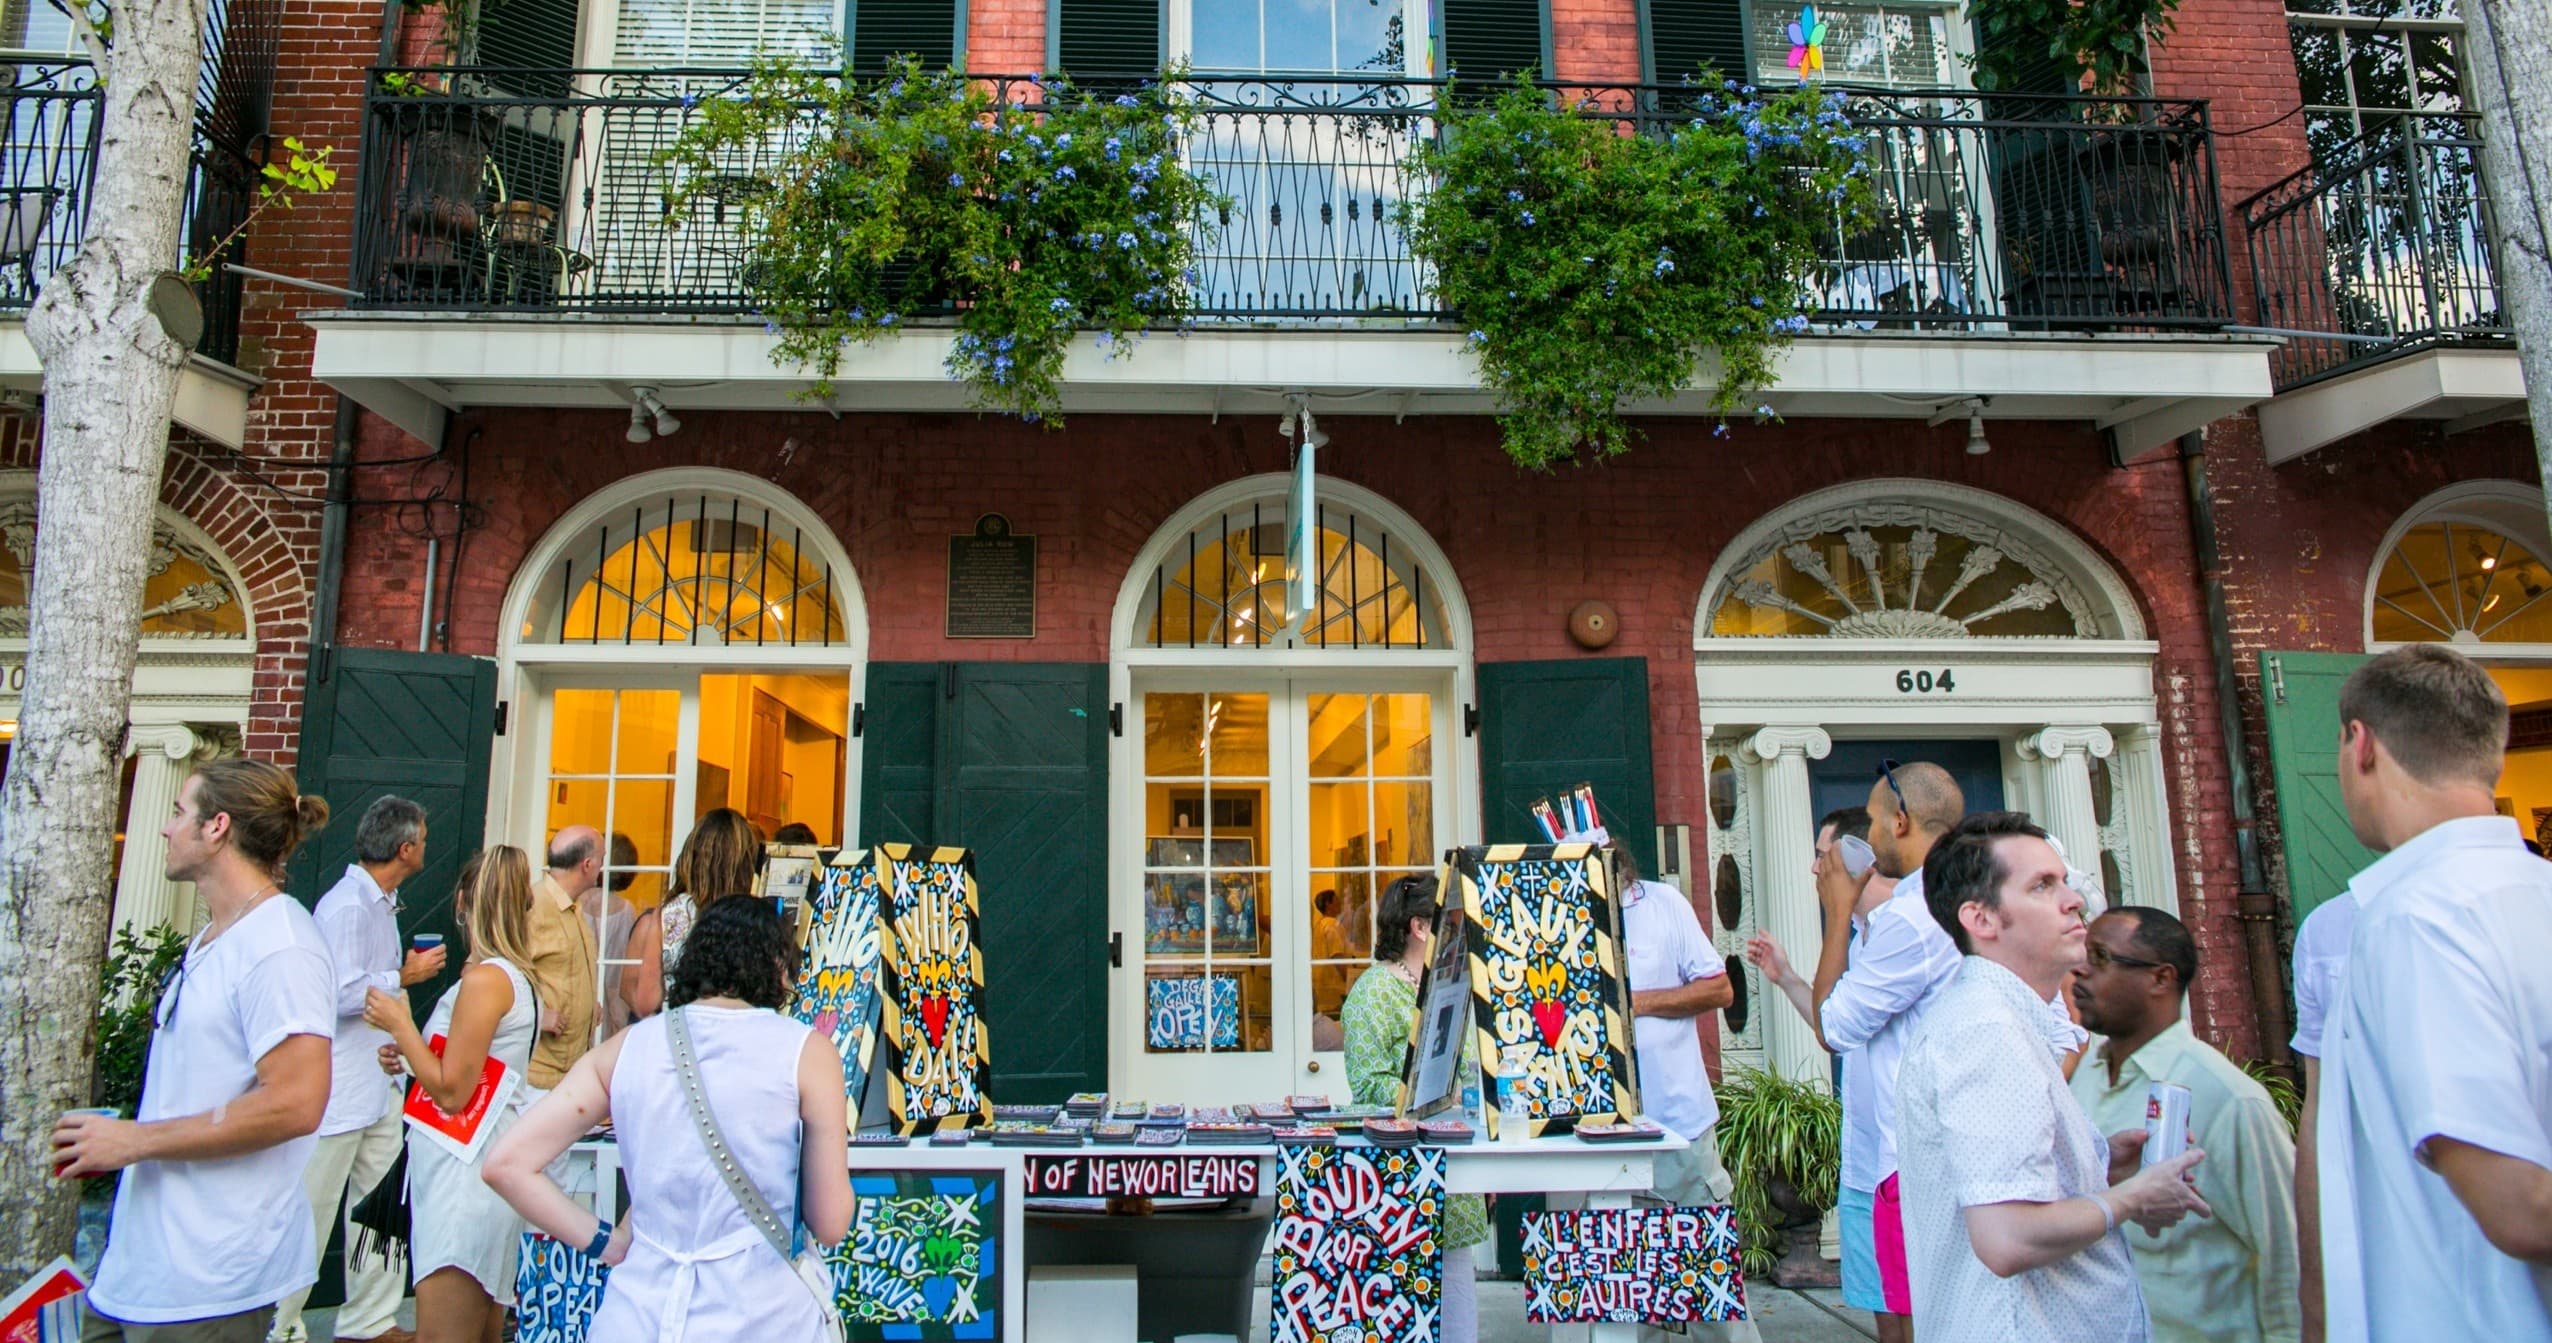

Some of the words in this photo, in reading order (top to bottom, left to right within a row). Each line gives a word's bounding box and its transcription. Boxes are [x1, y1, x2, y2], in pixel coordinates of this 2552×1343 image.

[1896, 668, 1955, 692] 604
[810, 888, 880, 976] WHO
[894, 884, 969, 965] WHO
[1487, 893, 1590, 993] GEAUX
[1157, 1004, 1224, 1039] OPEN
[1044, 1159, 1078, 1191] OF
[1274, 1151, 1431, 1268] BOUDIN
[1550, 1208, 1701, 1253] L'ENFER
[851, 1231, 923, 1275] 2016
[1316, 1228, 1373, 1278] FOR
[1544, 1247, 1618, 1282] C'EST
[1636, 1246, 1679, 1279] LES
[521, 1282, 598, 1331] SPEA
[856, 1263, 926, 1321] WAVE
[1280, 1270, 1413, 1343] PEACE
[1575, 1272, 1694, 1321] AUTRES
